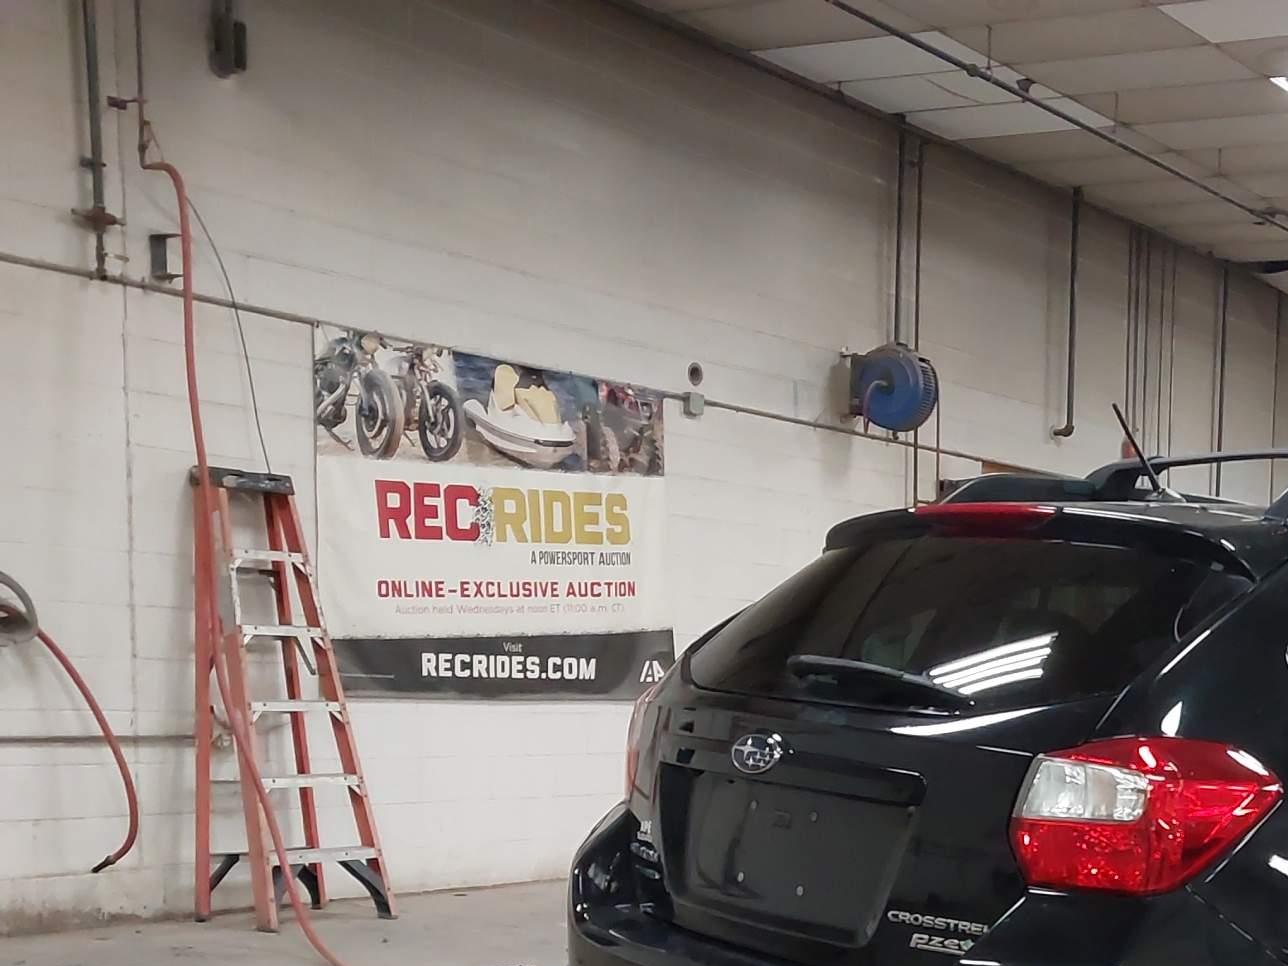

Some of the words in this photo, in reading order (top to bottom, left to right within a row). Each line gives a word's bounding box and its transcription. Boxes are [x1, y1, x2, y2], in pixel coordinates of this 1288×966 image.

[375, 480, 481, 541] REC
[491, 487, 631, 545] RIDES
[531, 551, 537, 565] A
[539, 551, 595, 565] POWERSPORT
[599, 552, 631, 566] AUCTION
[377, 580, 559, 598] ONLINE-EXCLUSIVE
[566, 581, 636, 598] AUCTION
[395, 605, 429, 615] Auction
[432, 605, 453, 615] held
[455, 605, 513, 617] Wednesdays
[515, 605, 525, 615] at
[550, 604, 560, 614] ET
[503, 642, 523, 653] Visit
[421, 652, 596, 680] RECRIDES.COM
